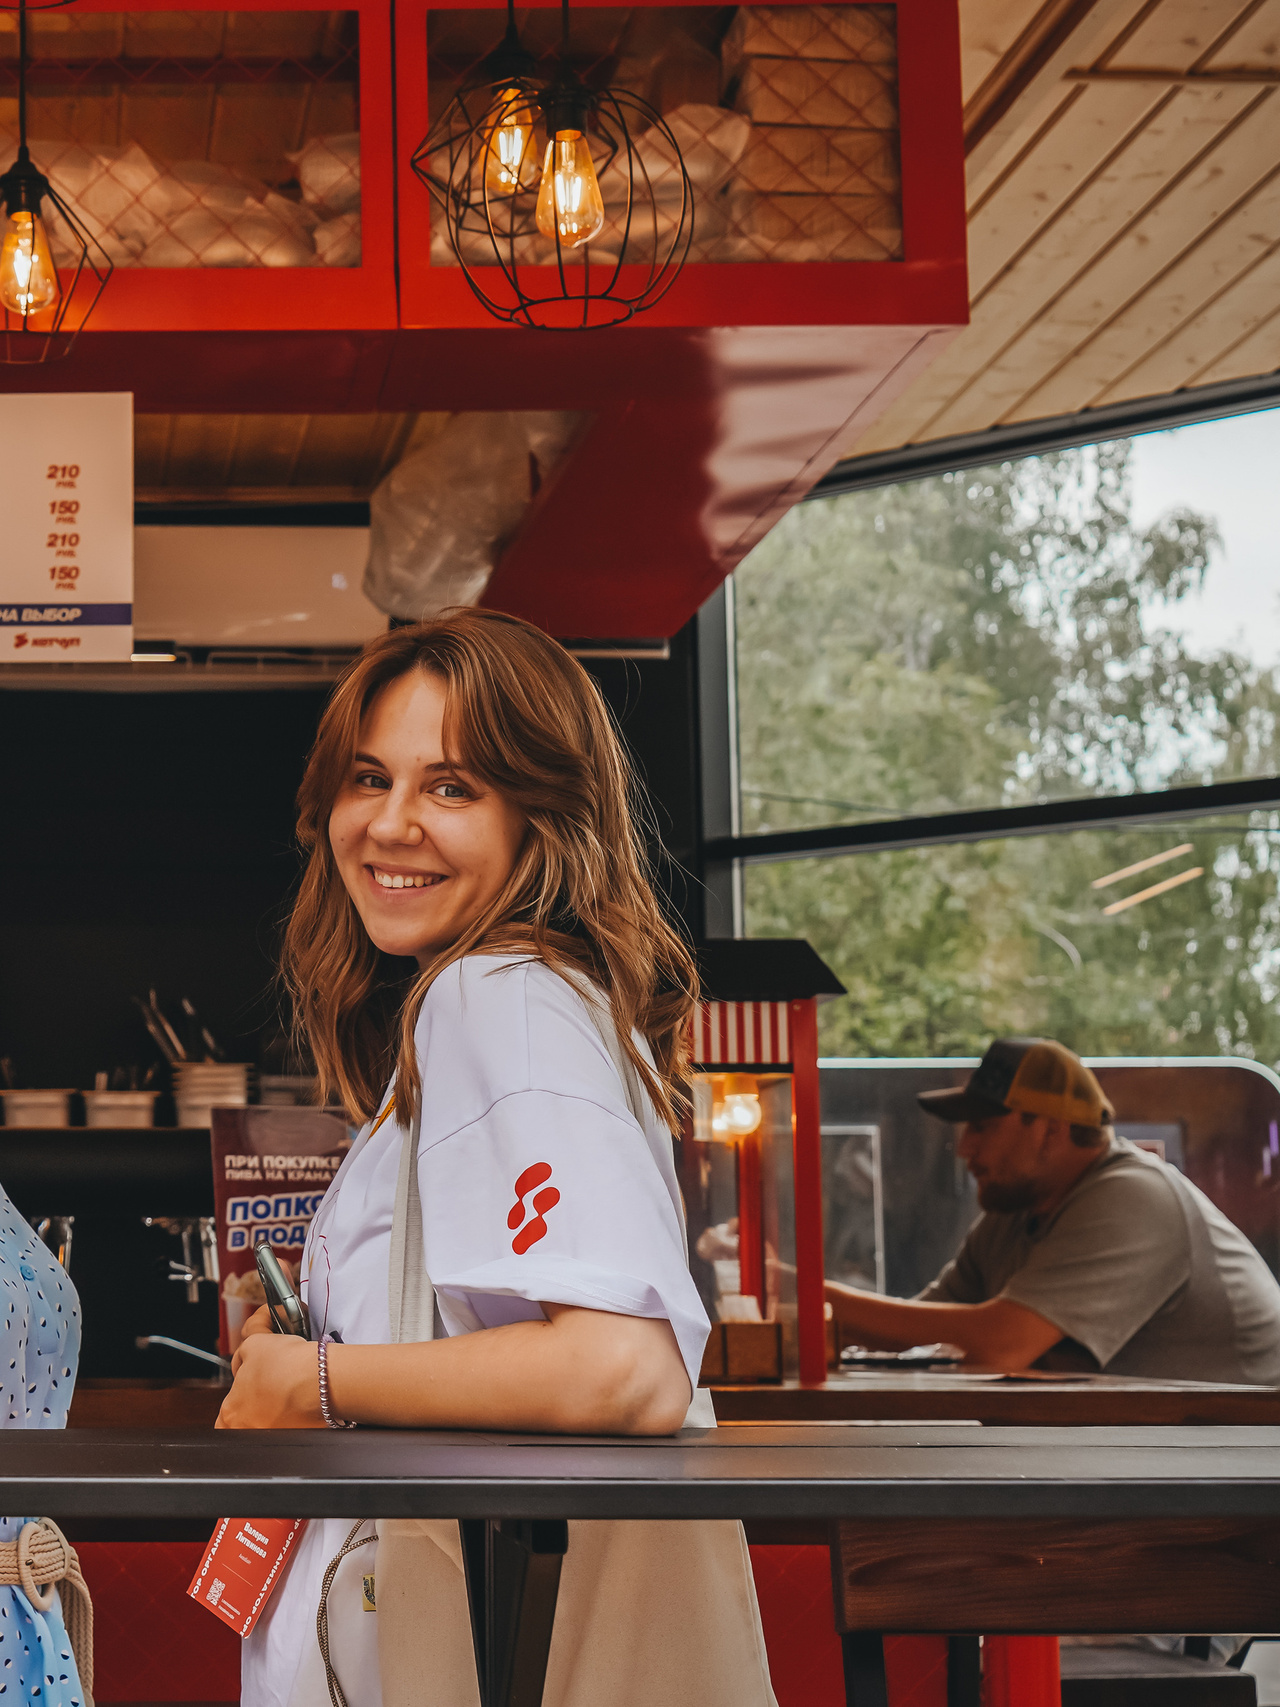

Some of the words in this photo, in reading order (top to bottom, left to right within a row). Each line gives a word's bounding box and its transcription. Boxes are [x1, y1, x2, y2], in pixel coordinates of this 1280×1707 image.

[47, 464, 81, 480] 210
[49, 500, 81, 515] 150
[47, 533, 81, 548] 210
[49, 566, 81, 581] 150
[21, 608, 82, 622] ВЫБОР
[225, 1155, 259, 1169] ПРИ
[263, 1155, 340, 1170] ПОКУПКЕ
[225, 1169, 263, 1181] ПИВА
[265, 1169, 284, 1181] НА
[231, 1230, 246, 1247] В
[243, 1522, 270, 1546] Валерия
[235, 1531, 267, 1559] Литвинова
[252, 1531, 295, 1615] ОРГАНИЗАТОР
